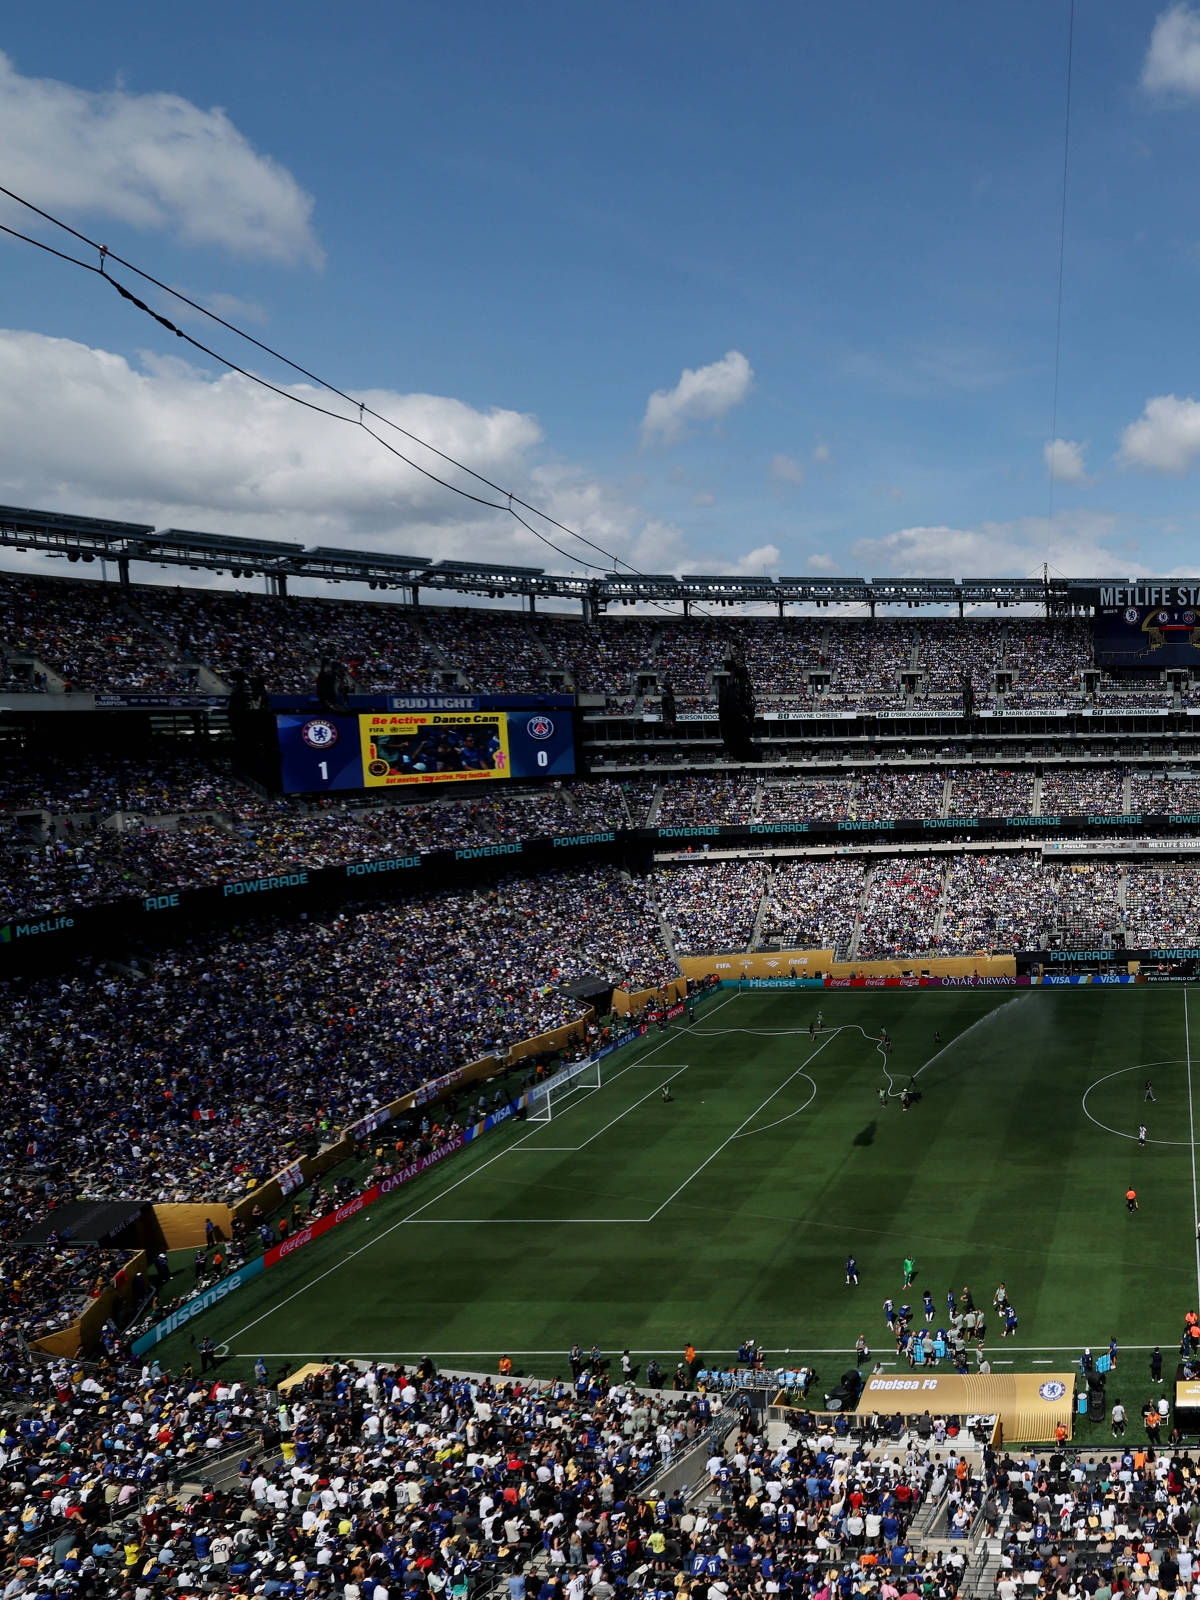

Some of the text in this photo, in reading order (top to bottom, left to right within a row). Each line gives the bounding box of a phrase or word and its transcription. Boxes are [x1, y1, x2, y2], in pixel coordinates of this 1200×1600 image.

[1100, 586, 1172, 606] METLIFE
[393, 697, 474, 710] BUD LIGHT
[372, 715, 499, 725] Be Active Dance Cam
[536, 750, 548, 768] 0
[318, 761, 328, 780] 1
[837, 820, 895, 831] POWERADE
[922, 817, 979, 829] POWERADE
[1005, 816, 1061, 826] POWERADE
[1087, 815, 1142, 826] POWERADE
[658, 825, 721, 838] POWERADE
[749, 823, 809, 835] POWERADE
[552, 831, 616, 848] POWERADE
[1063, 841, 1088, 849] MetLife
[1148, 841, 1177, 849] METLIFE
[455, 842, 524, 861] POWERADE
[346, 854, 422, 877] POWERADE
[223, 871, 309, 898] POWERADE
[15, 915, 76, 937] MetLife
[1050, 950, 1116, 961] POWERADE
[749, 979, 797, 988] Hisense
[941, 977, 1017, 987] QATAR AIRWAYS
[1050, 976, 1070, 984] VISA
[1100, 976, 1121, 984] VISA
[617, 1033, 635, 1047] ULTRA
[491, 1104, 512, 1124] VISA
[381, 1137, 463, 1193] QATAR AIRWAYS
[154, 1274, 243, 1343] Hisense
[869, 1379, 938, 1390] Chelsea FC
[1036, 1529, 1042, 1538] 8
[214, 1543, 227, 1553] 20
[693, 1559, 703, 1571] 17
[708, 1562, 716, 1572] 11
[575, 1579, 585, 1593] 10
